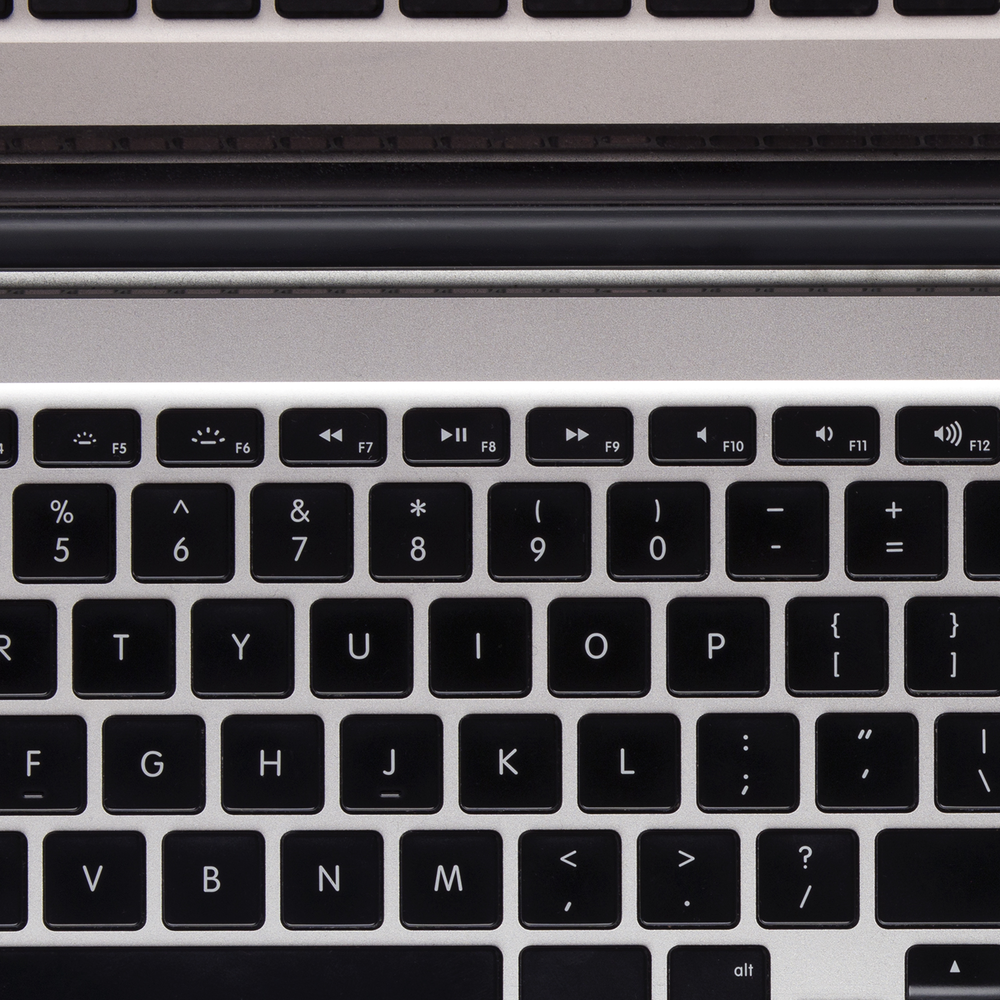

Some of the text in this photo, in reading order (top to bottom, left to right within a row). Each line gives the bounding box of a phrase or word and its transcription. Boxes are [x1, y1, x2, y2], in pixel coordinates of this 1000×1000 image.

[112, 442, 127, 455] F5
[235, 442, 251, 454] F6
[358, 441, 374, 454] F7
[481, 440, 497, 453] F8
[605, 441, 620, 453] F9
[723, 440, 745, 452] F10
[849, 440, 867, 452] F11
[969, 439, 991, 452] F12
[50, 499, 74, 524] %
[290, 498, 310, 523] &
[535, 499, 541, 523] (
[654, 498, 661, 523] )
[884, 501, 903, 519] +
[53, 537, 70, 563] 5
[173, 536, 190, 562] 6
[291, 536, 308, 562] 7
[410, 536, 427, 562] 8
[530, 536, 546, 562] 9
[649, 535, 667, 561] 0
[885, 541, 904, 553] =
[830, 612, 841, 639] {
[949, 612, 960, 639] }
[112, 633, 130, 661] T
[231, 633, 251, 661] Y
[348, 632, 370, 660] U
[475, 632, 481, 660] I
[584, 632, 609, 660] O
[707, 632, 726, 660] P
[833, 651, 840, 678] [
[950, 651, 957, 678] ]
[26, 750, 42, 777] F
[140, 750, 164, 778] G
[259, 749, 282, 777] H
[382, 748, 396, 776] J
[498, 748, 519, 776] K
[620, 747, 636, 775] L
[559, 850, 577, 868] <
[678, 850, 696, 868] >
[799, 845, 813, 869] ?
[82, 864, 104, 892] V
[203, 865, 221, 893] B
[318, 864, 340, 892] N
[433, 864, 463, 892] M
[799, 884, 812, 909] /
[733, 962, 754, 977] alt
